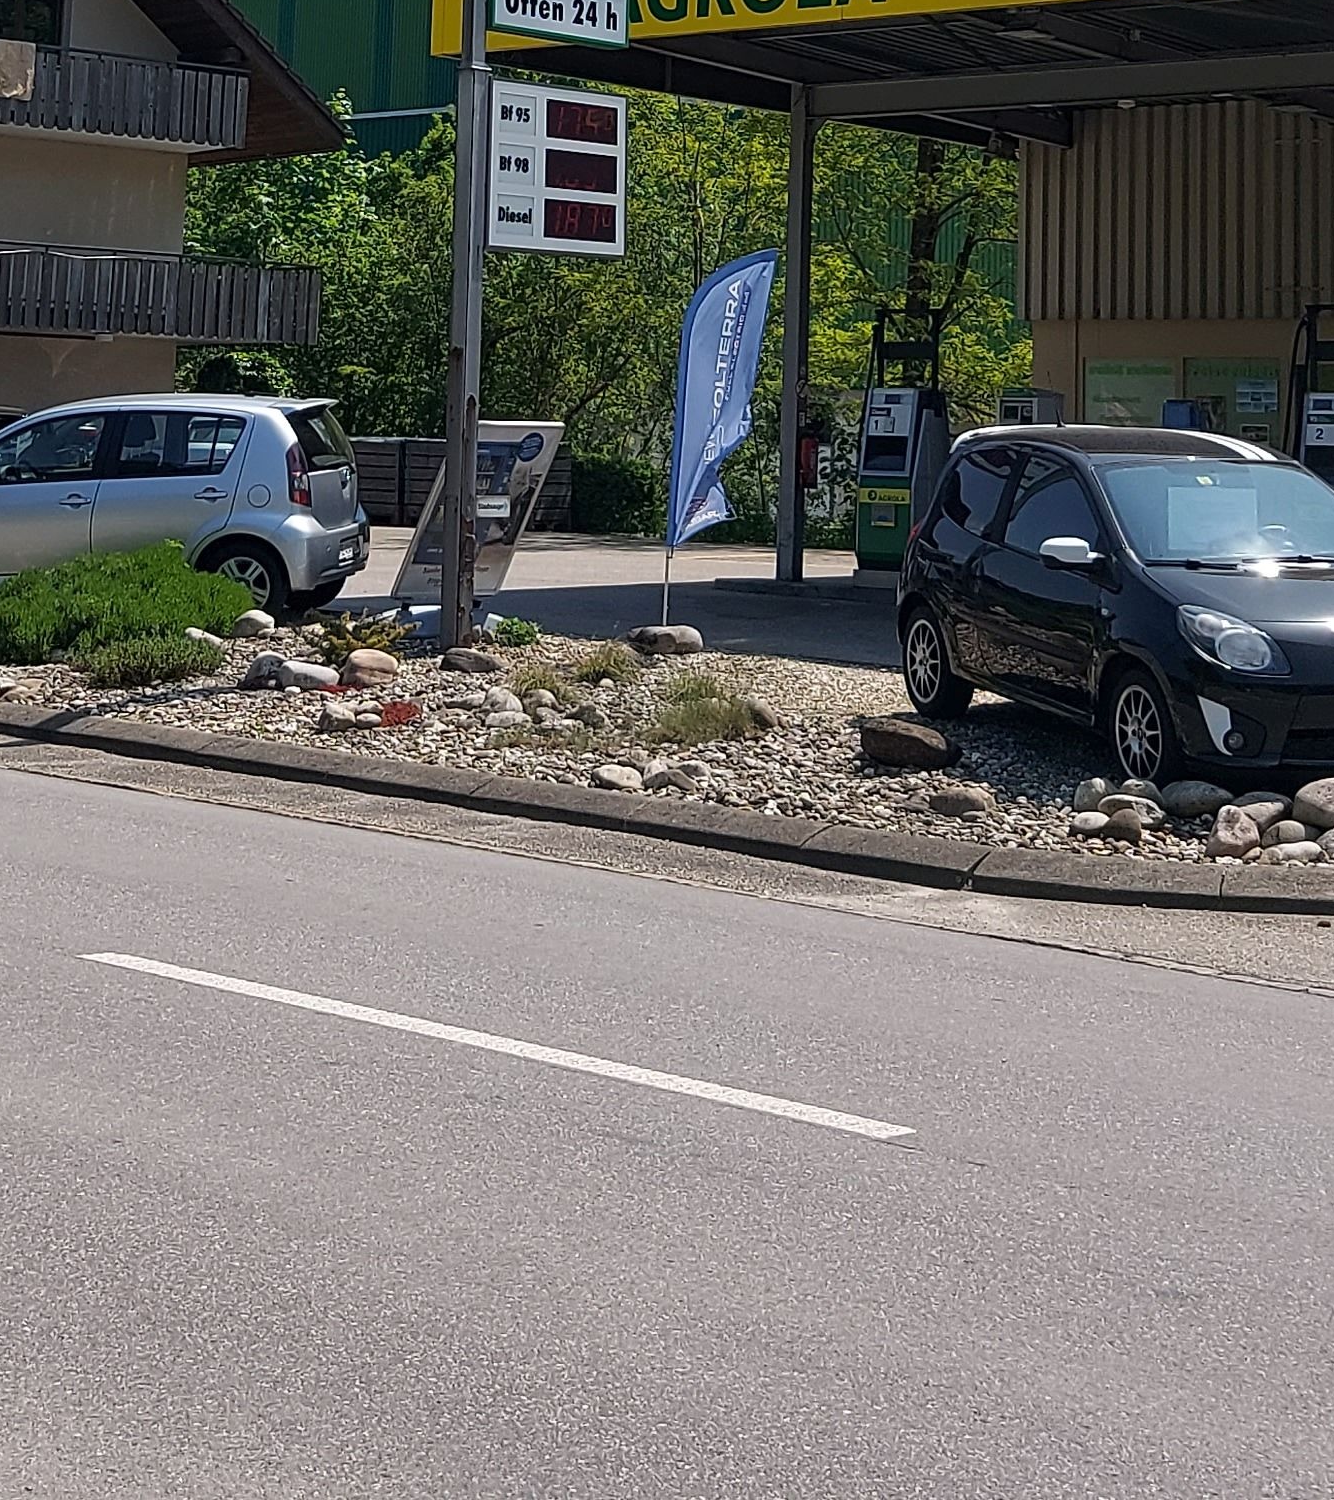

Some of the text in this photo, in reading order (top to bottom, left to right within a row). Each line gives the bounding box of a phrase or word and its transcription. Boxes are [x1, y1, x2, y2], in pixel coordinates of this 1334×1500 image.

[606, 2, 618, 31] h
[500, 104, 530, 123] Bf 95
[499, 155, 529, 173] Bf 98
[497, 206, 532, 224] Diesel
[874, 419, 879, 431] 1
[1315, 428, 1324, 440] 2
